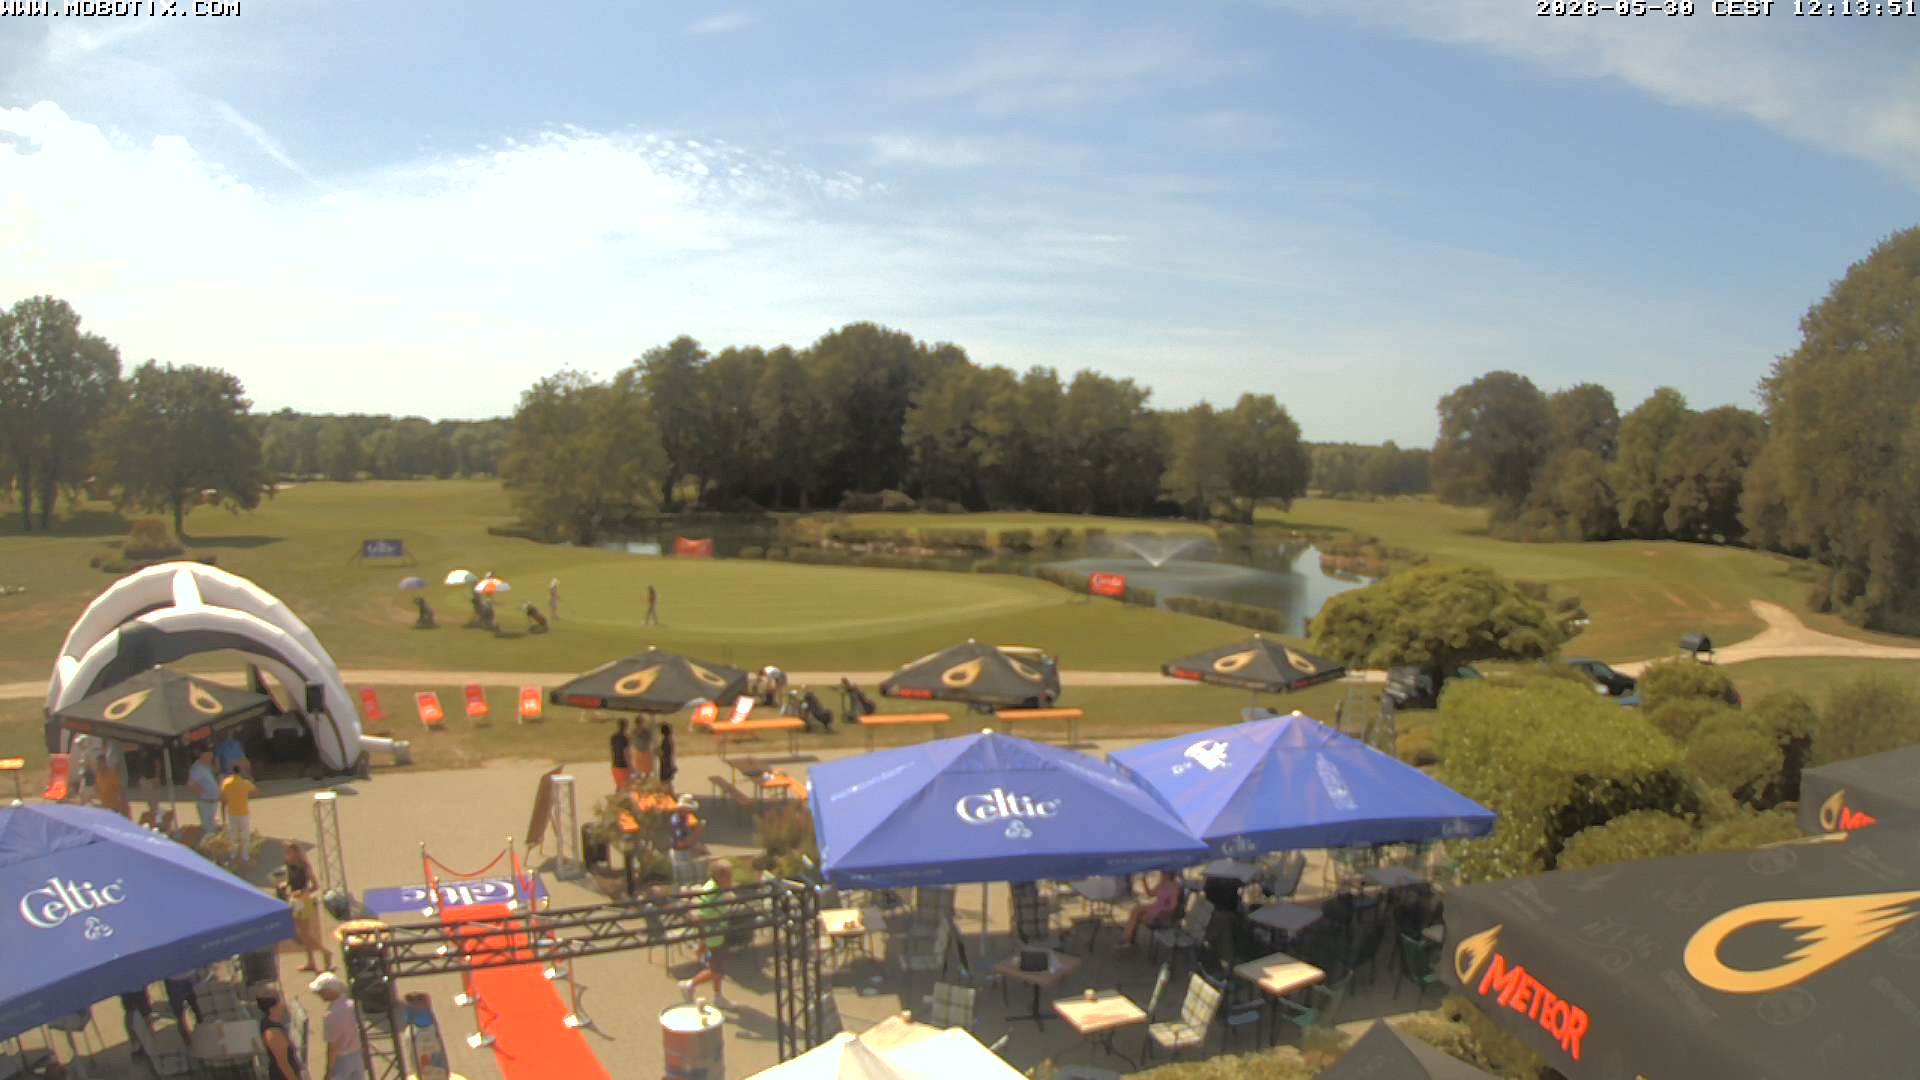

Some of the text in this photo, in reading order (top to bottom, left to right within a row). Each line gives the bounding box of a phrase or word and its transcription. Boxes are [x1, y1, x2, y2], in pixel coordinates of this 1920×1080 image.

[956, 787, 1059, 824] Celtic
[19, 876, 126, 929] Celtic
[1478, 951, 1591, 1062] METEOR
